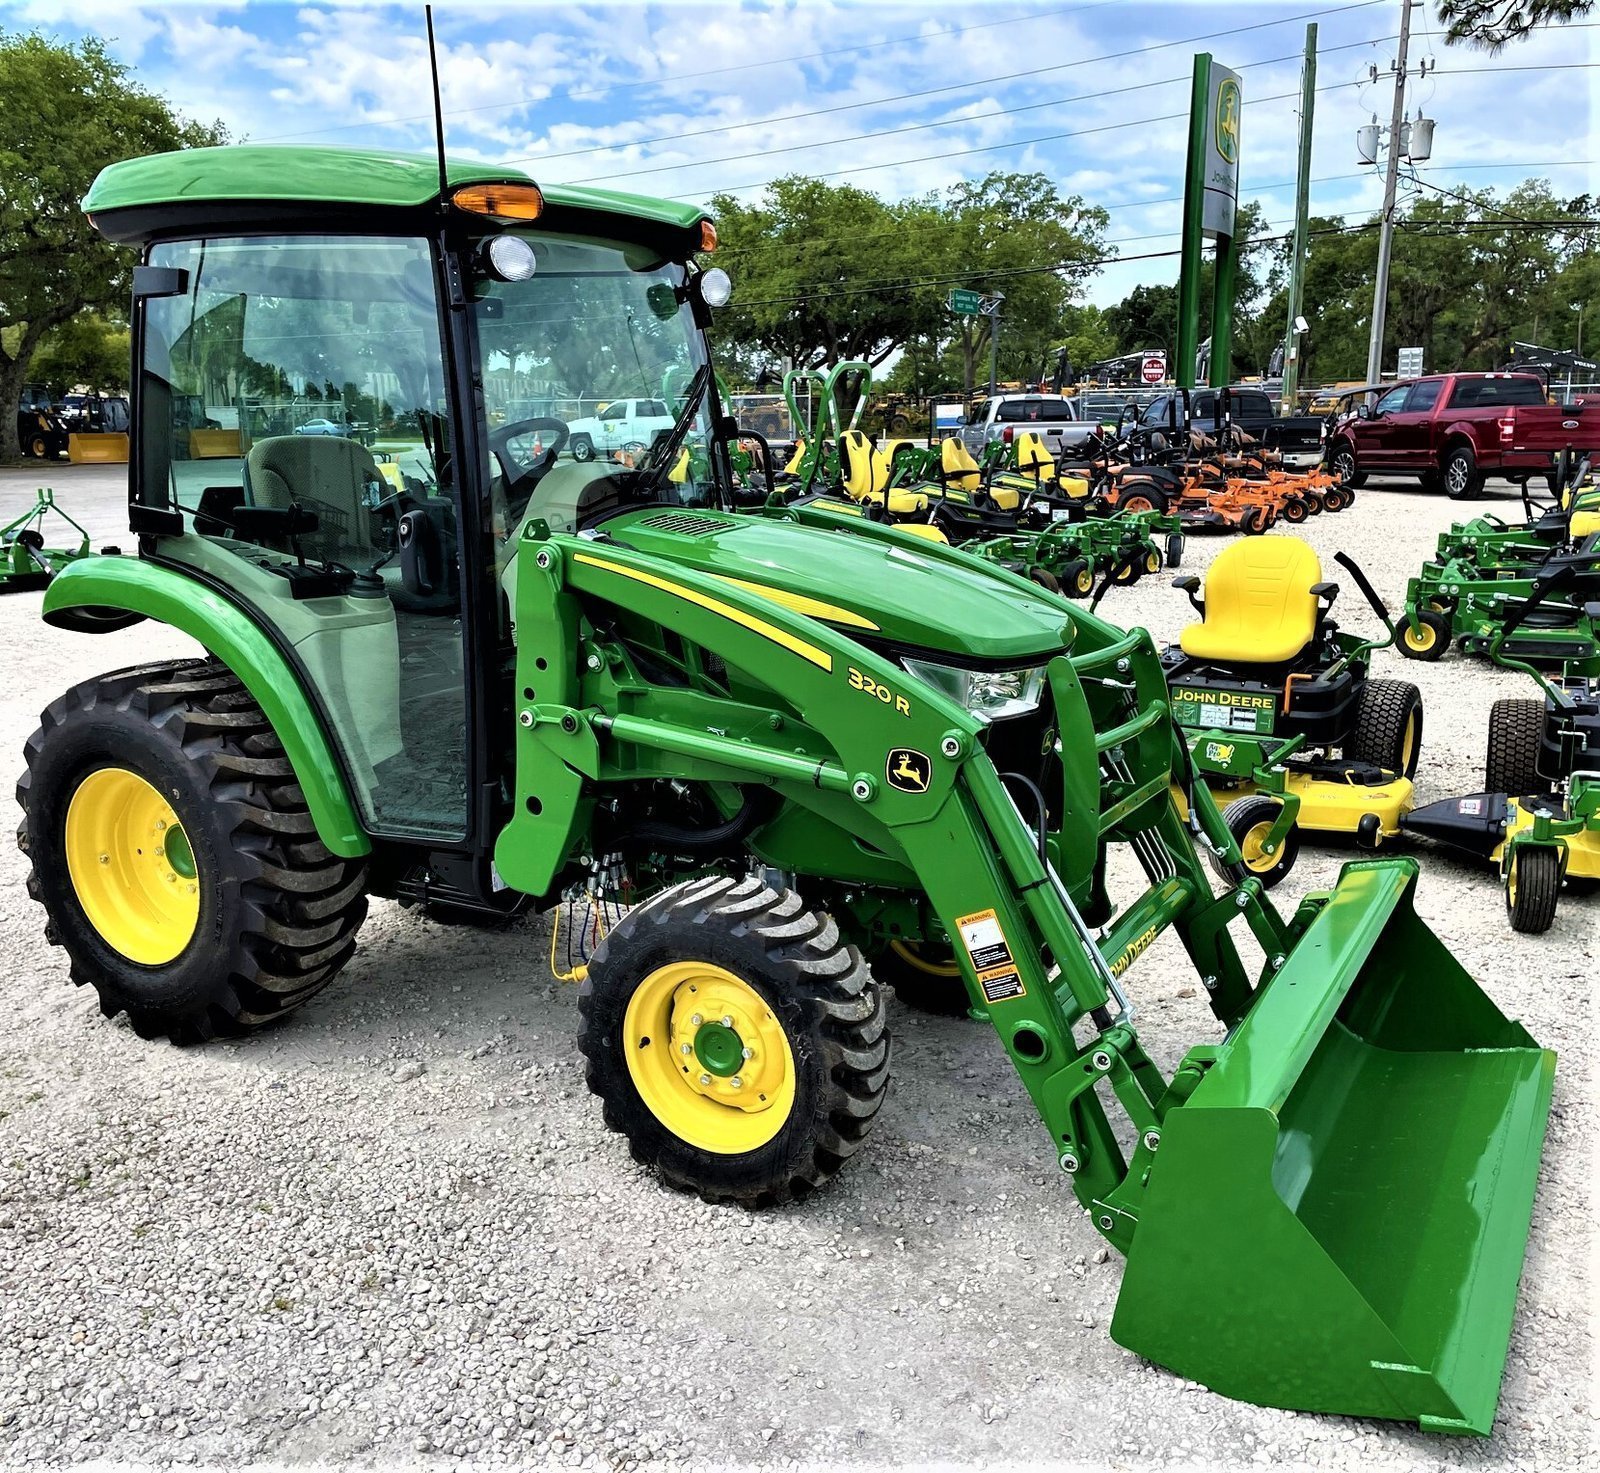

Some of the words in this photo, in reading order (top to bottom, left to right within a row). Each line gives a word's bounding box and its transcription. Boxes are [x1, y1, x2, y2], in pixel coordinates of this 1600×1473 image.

[1573, 360, 1597, 369] VOLVO
[848, 666, 892, 704] 320
[895, 694, 911, 718] R
[1174, 689, 1216, 704] JOHN
[1219, 692, 1273, 709] DEERE
[1126, 924, 1157, 962] DEERE
